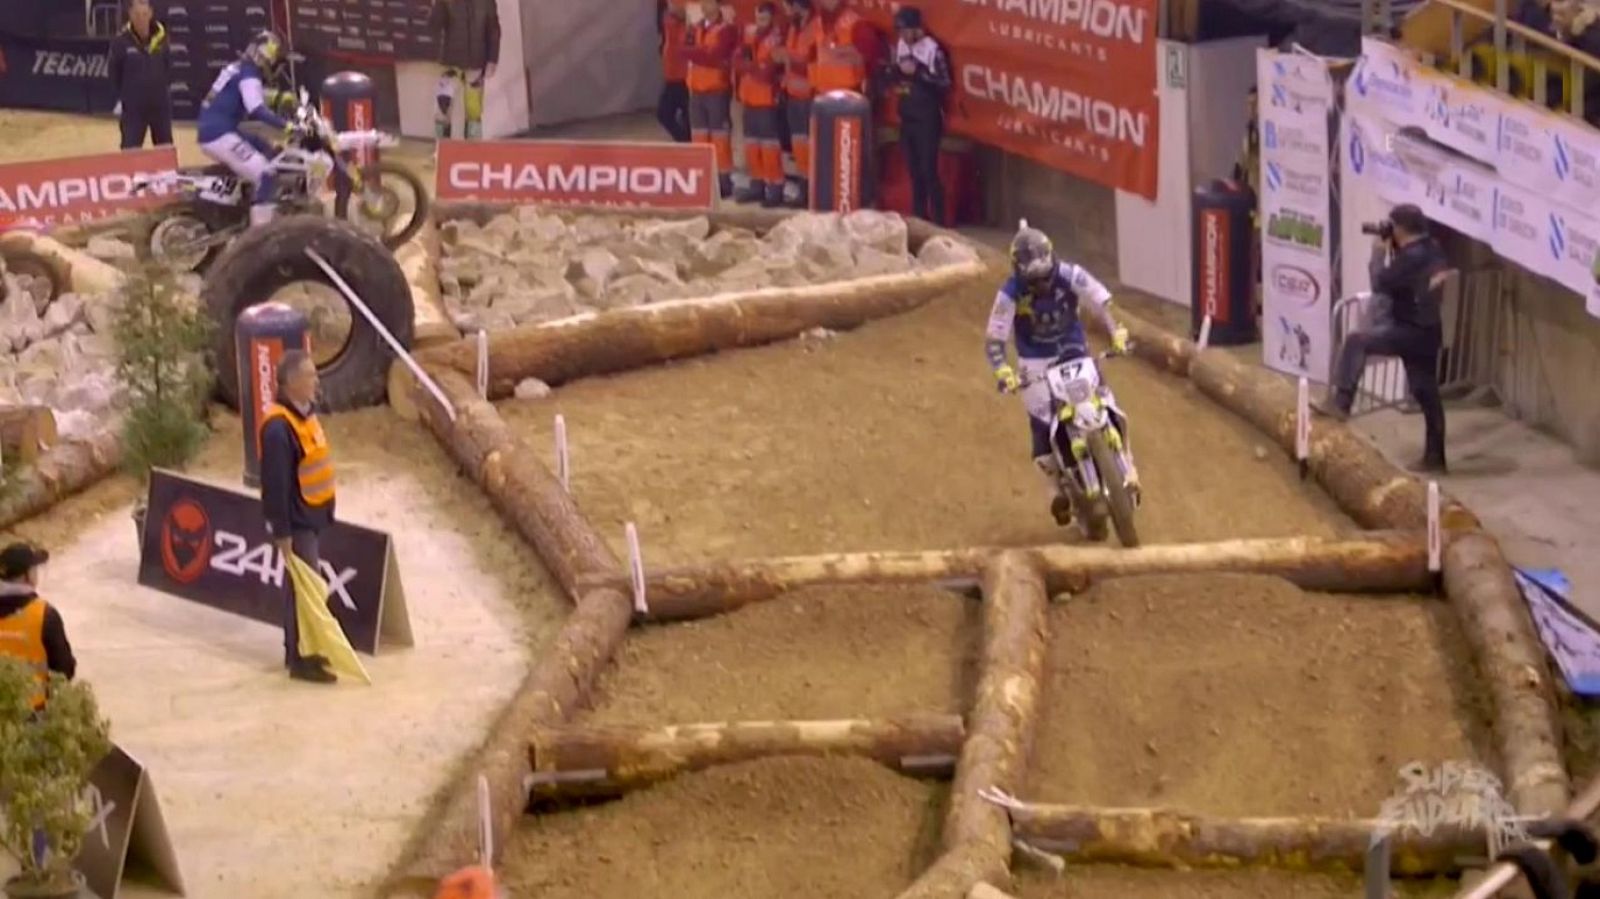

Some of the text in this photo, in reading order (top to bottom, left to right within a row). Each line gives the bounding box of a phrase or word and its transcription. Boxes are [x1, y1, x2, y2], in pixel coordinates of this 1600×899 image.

[962, 64, 1147, 146] CHAMPION
[450, 161, 699, 195] CHAMPION
[209, 529, 358, 611] 24X
